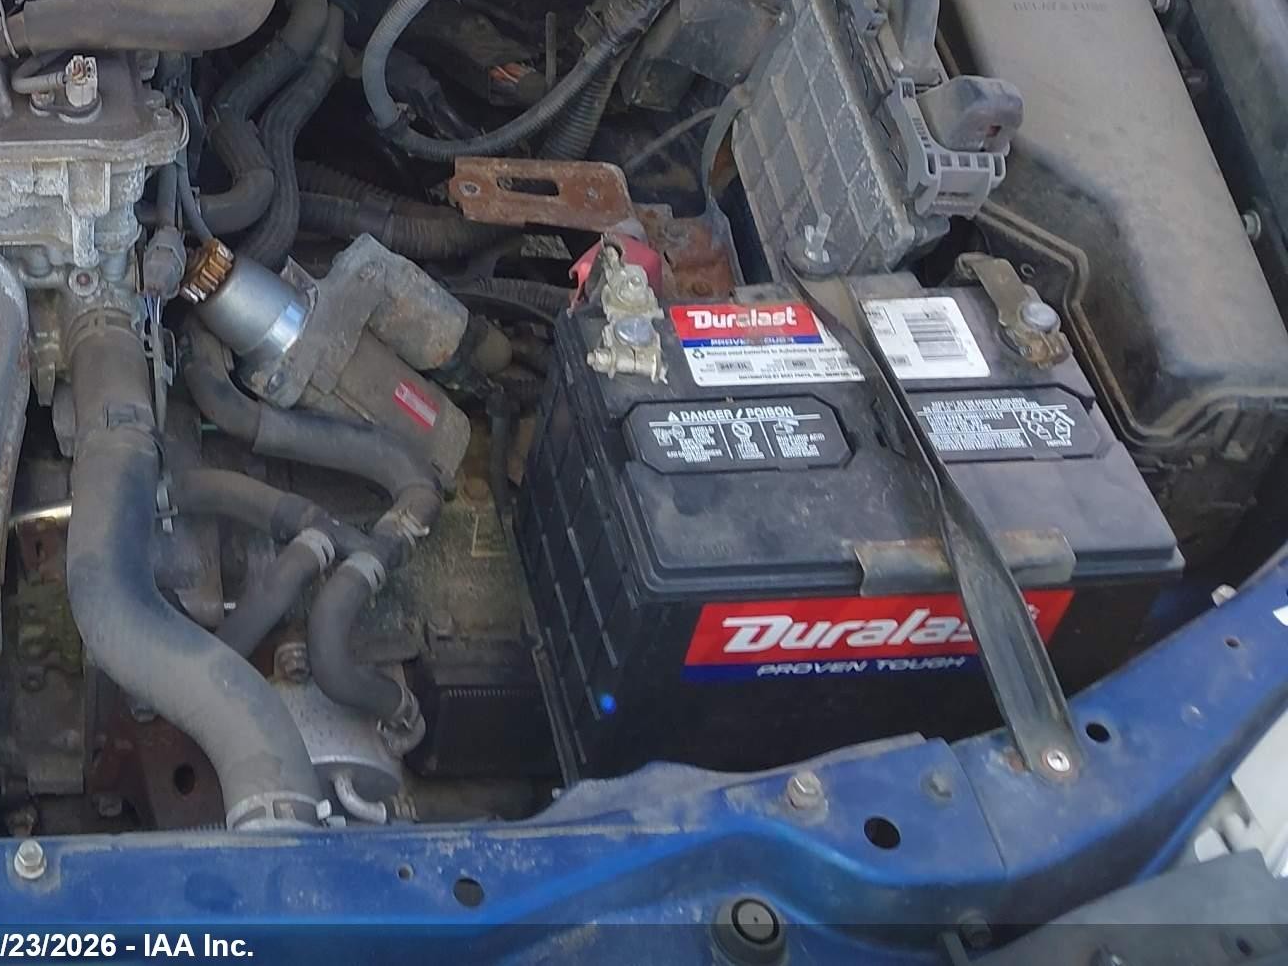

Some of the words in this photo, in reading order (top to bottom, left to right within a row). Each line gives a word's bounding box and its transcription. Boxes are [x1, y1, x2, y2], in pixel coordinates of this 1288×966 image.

[686, 306, 797, 330] Duralast
[679, 409, 734, 422] DANGER
[745, 406, 795, 419] POISON
[756, 660, 867, 676] PROVEN
[876, 656, 966, 671] TOUGH
